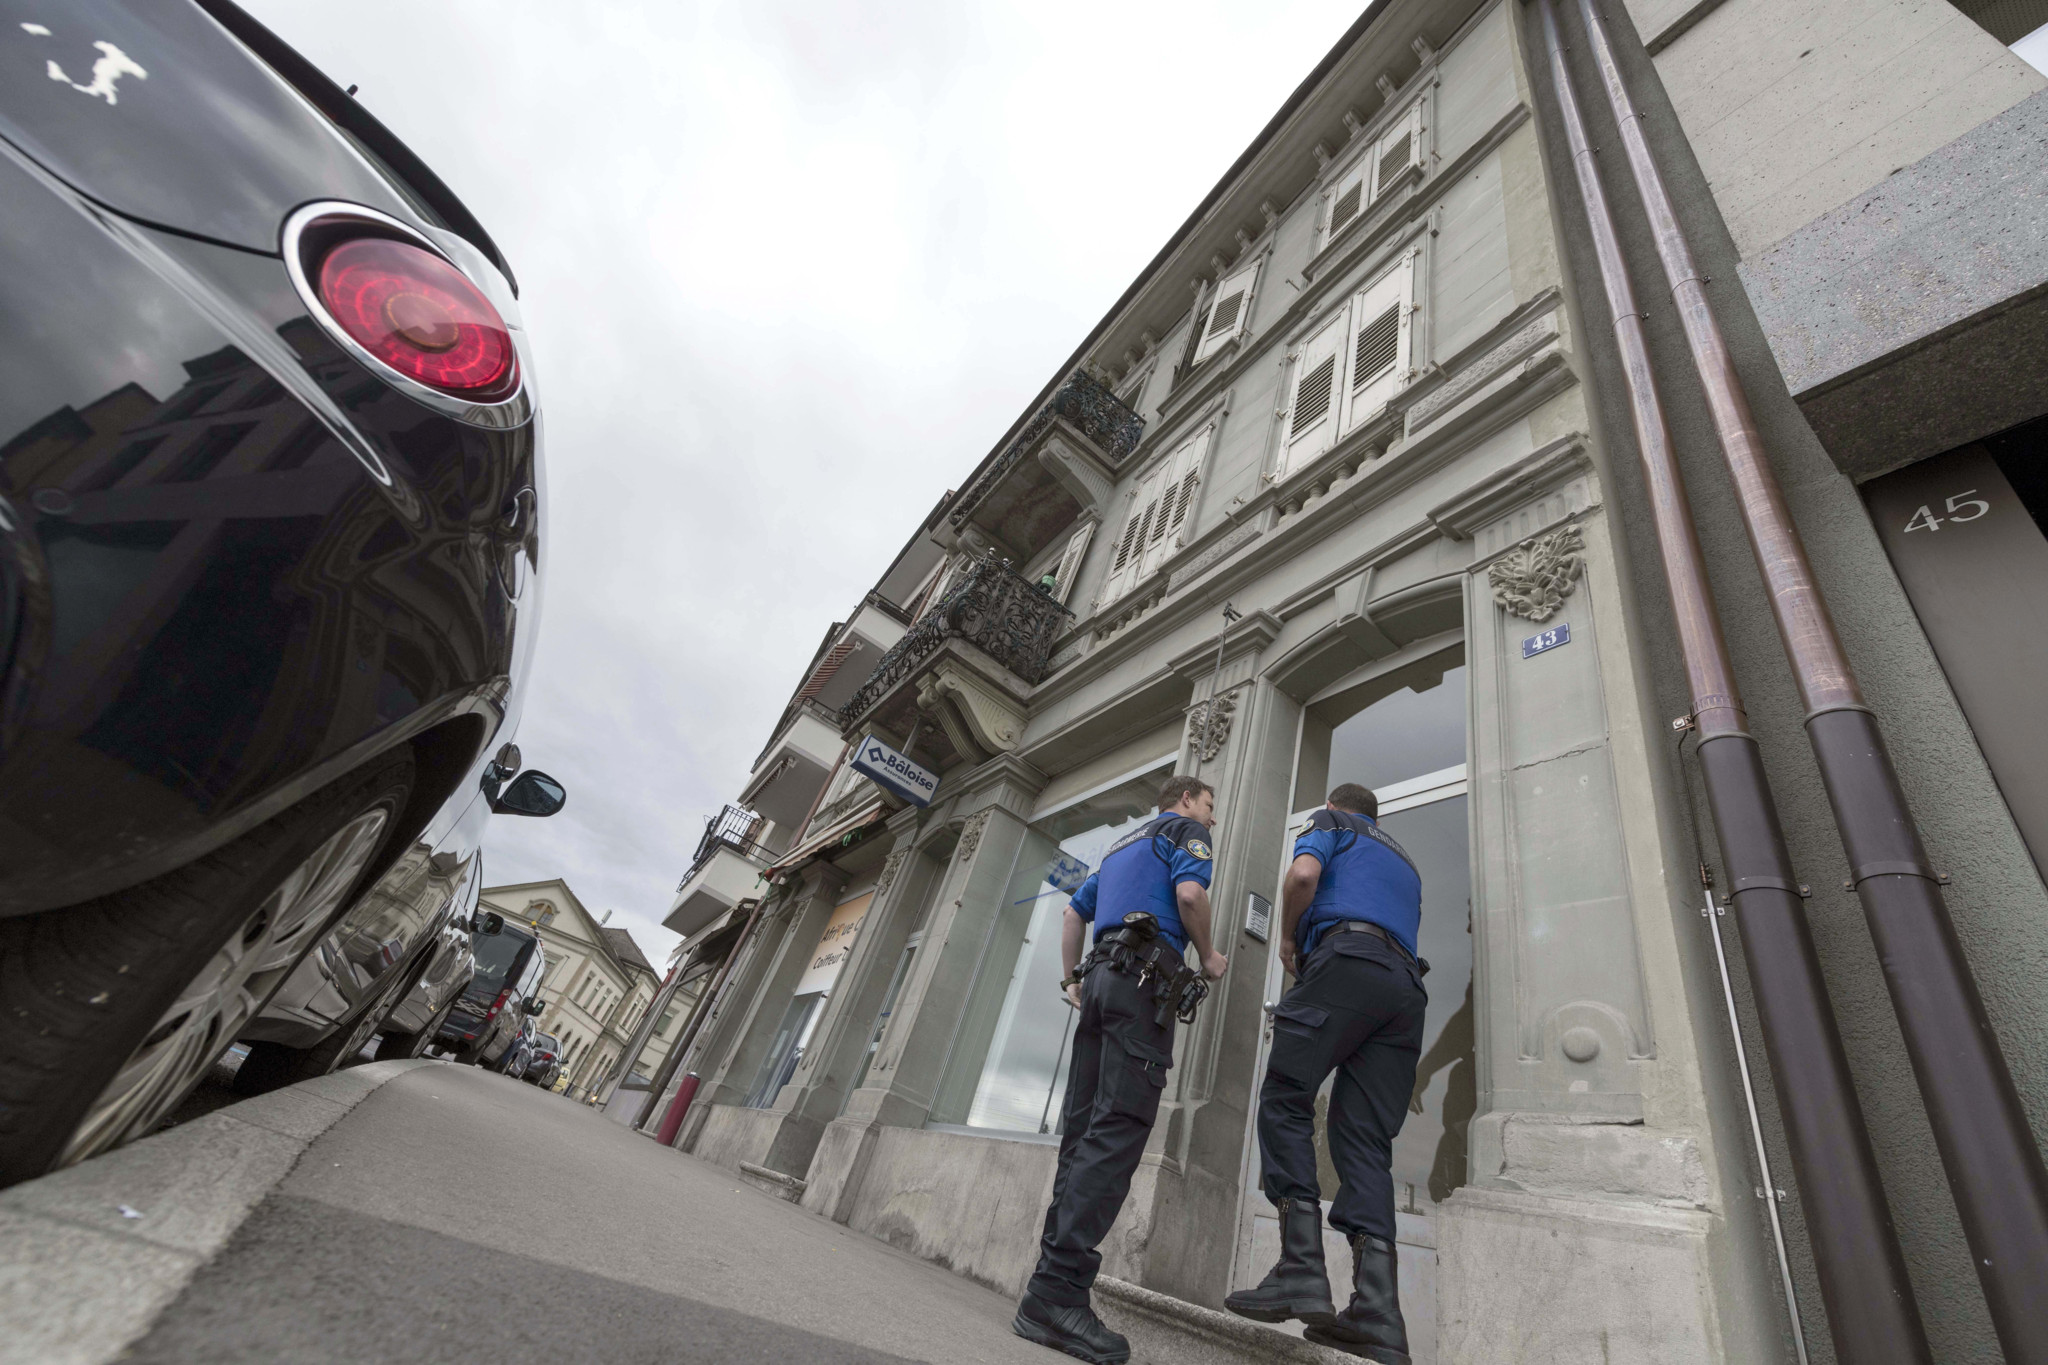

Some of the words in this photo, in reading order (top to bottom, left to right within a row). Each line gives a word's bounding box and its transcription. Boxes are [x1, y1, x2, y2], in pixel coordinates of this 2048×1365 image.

[1904, 489, 1990, 533] 45
[1532, 630, 1557, 651] 43
[886, 754, 934, 791] Bâloise
